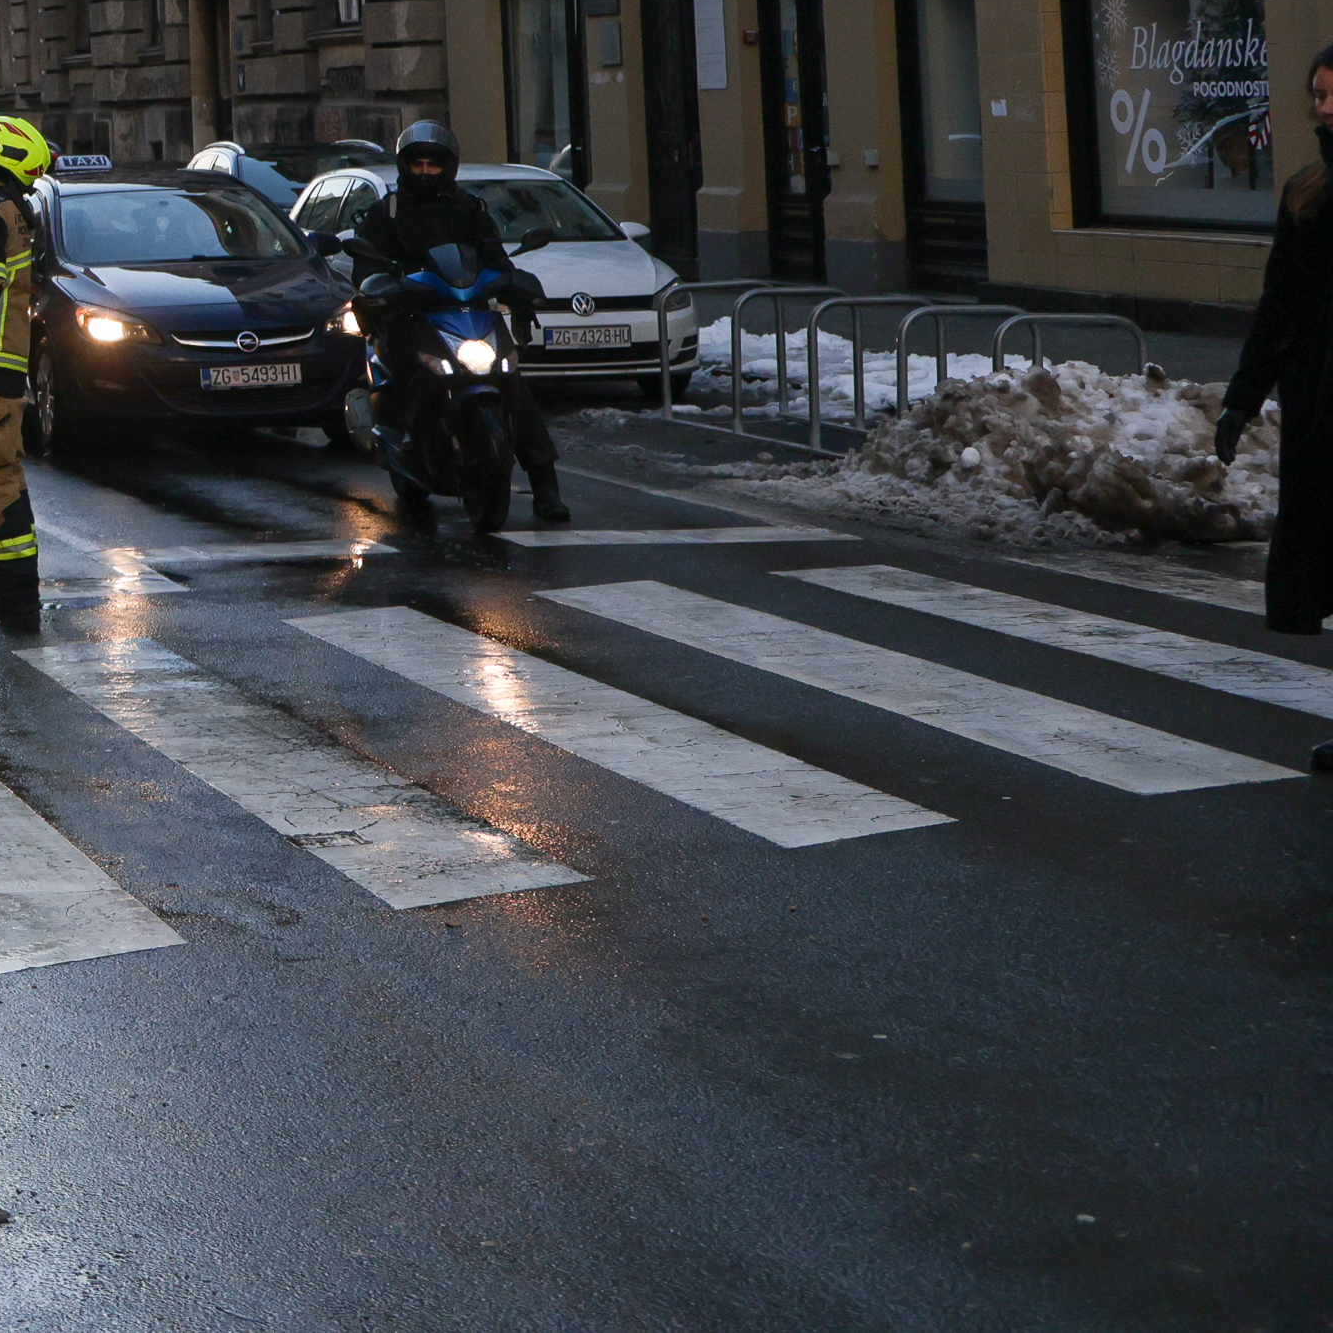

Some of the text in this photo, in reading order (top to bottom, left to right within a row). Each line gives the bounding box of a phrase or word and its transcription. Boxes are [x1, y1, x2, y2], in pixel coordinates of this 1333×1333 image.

[63, 156, 106, 166] TAXI
[555, 331, 571, 345] ZG
[212, 369, 231, 385] ZG
